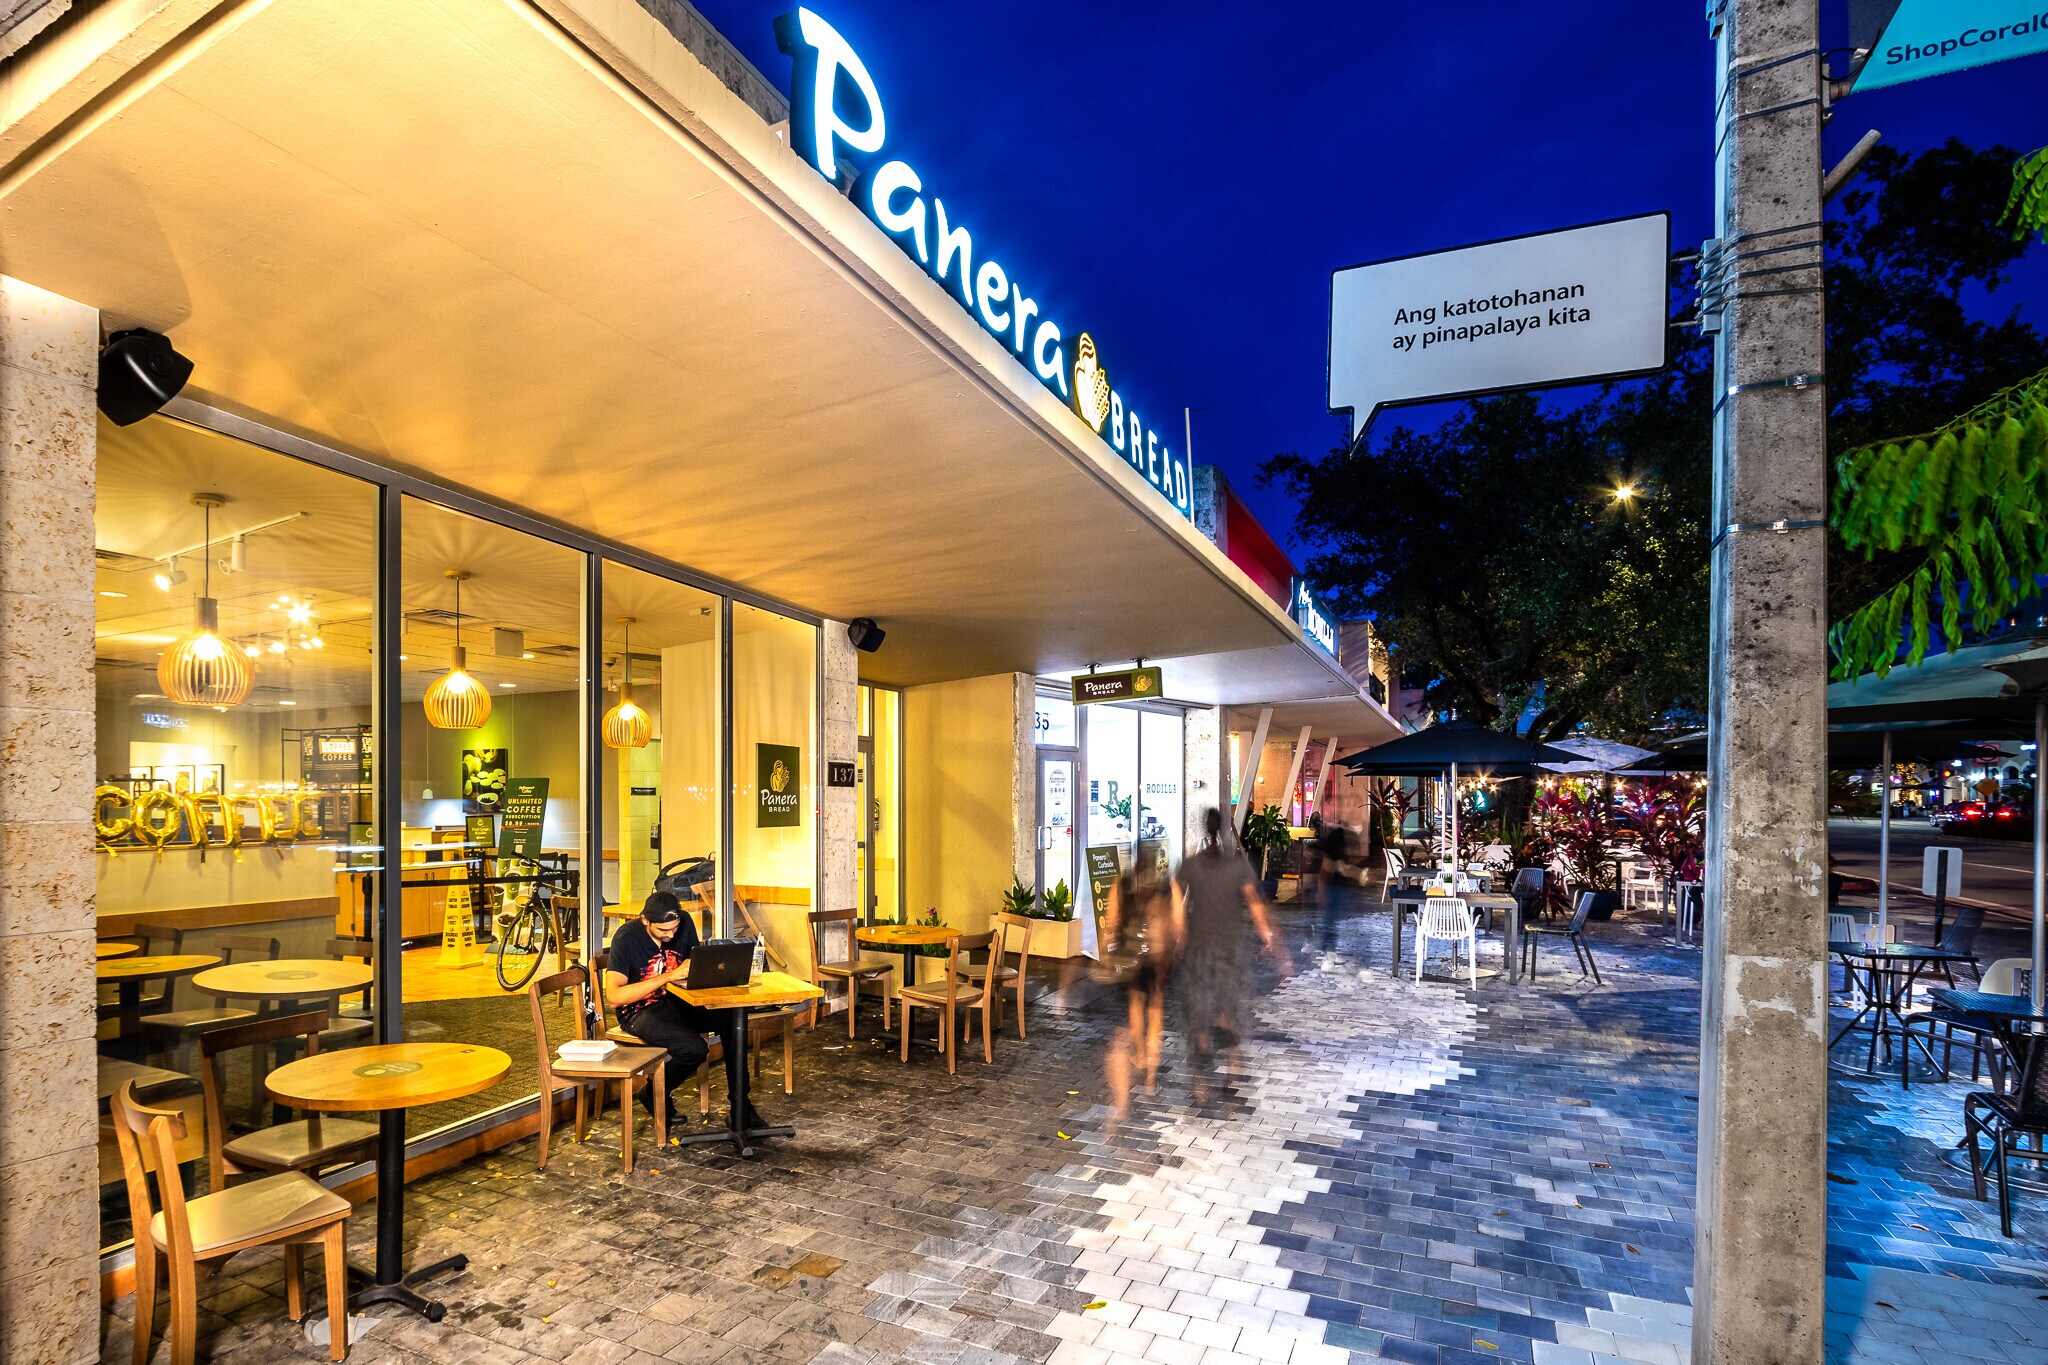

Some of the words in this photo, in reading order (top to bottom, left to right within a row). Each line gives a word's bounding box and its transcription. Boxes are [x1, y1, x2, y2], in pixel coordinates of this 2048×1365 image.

[799, 5, 1068, 396] Panera
[1110, 390, 1188, 510] BREAD
[1393, 307, 1436, 325] Ang
[1443, 284, 1585, 318] katotohanan
[1392, 334, 1417, 352] ay
[1422, 315, 1541, 349] pinapalaya
[1548, 307, 1591, 327] kita
[1084, 681, 1123, 693] Panera
[322, 754, 353, 762] COFFEE
[832, 767, 854, 783] 137
[760, 788, 798, 806] Panera
[1146, 783, 1177, 794] RODILLA
[95, 784, 323, 848] COFFEE
[506, 806, 542, 814] COFFEE
